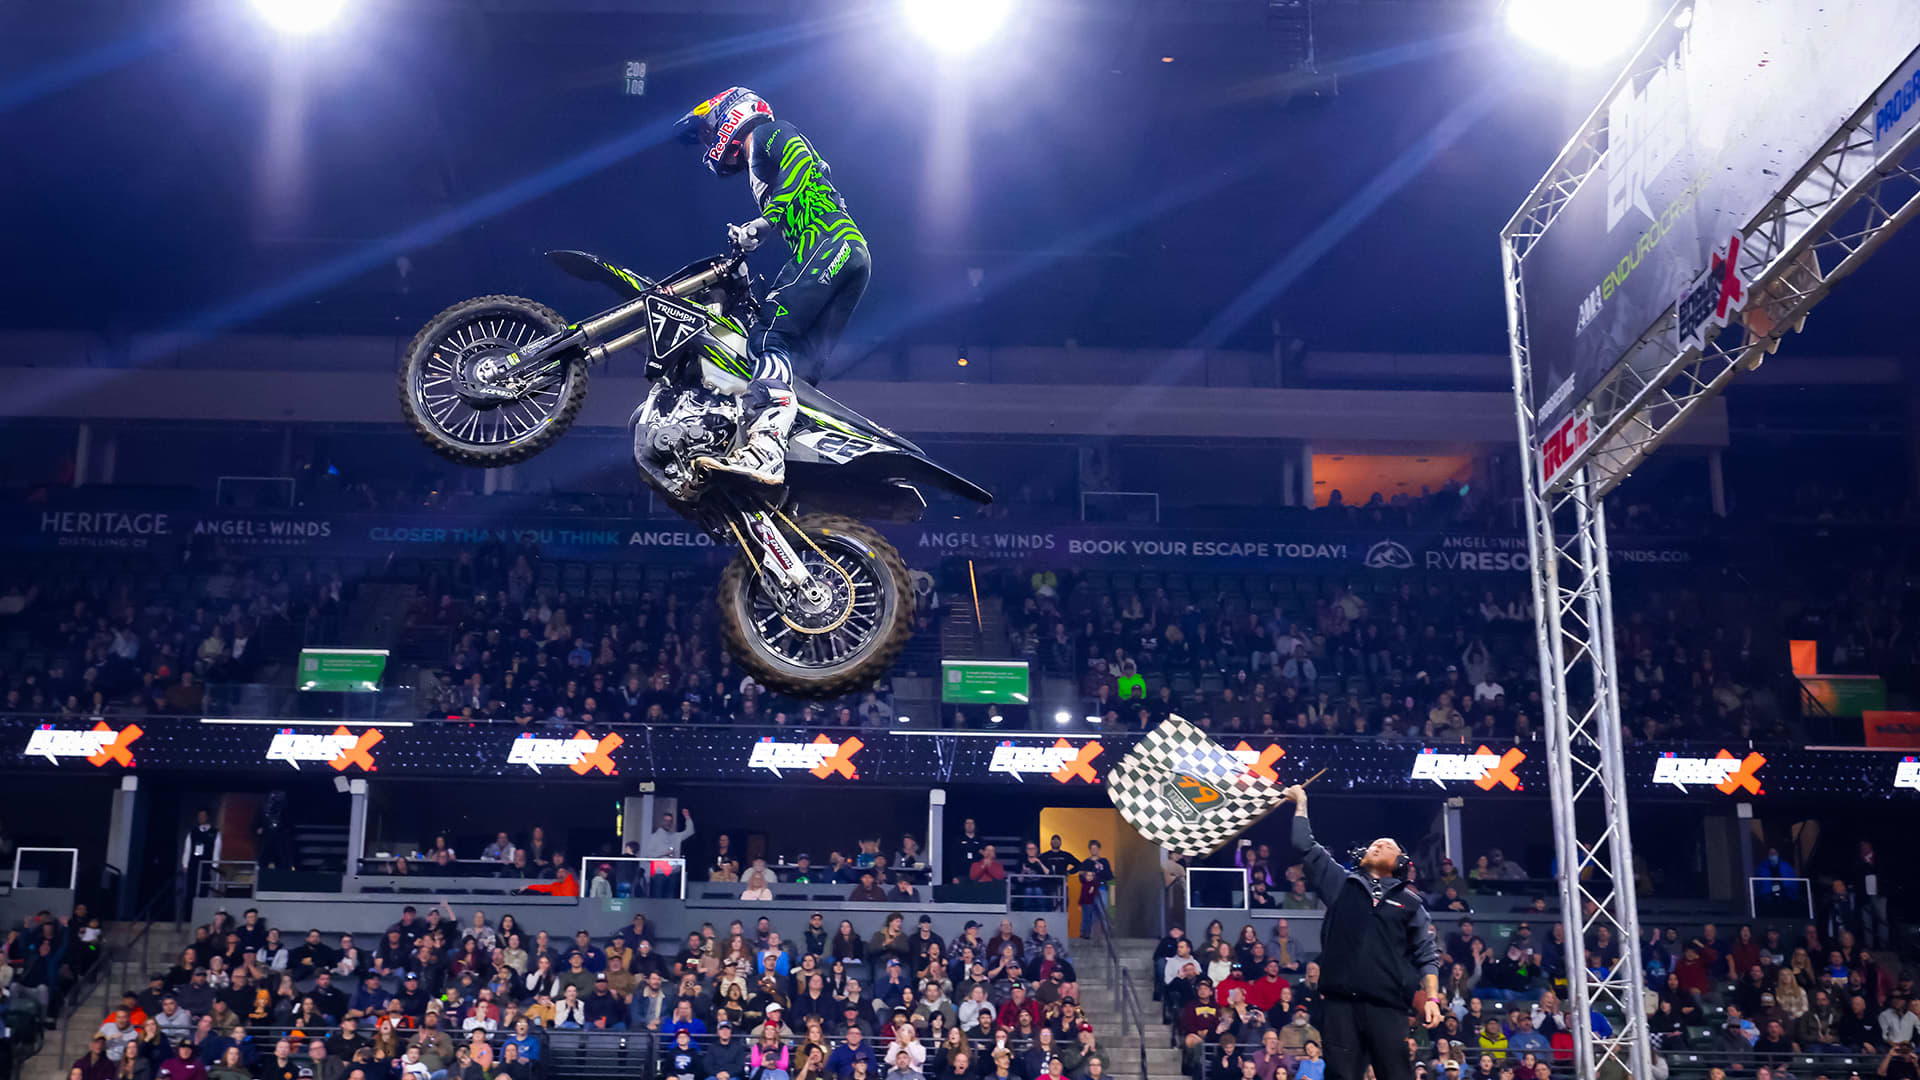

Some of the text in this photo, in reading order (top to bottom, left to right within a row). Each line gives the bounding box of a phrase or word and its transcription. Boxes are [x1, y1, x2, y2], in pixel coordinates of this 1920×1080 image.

[709, 132, 729, 161] Red
[721, 108, 745, 136] Bull
[656, 302, 697, 324] TRIUMPH
[816, 432, 874, 458] 22
[40, 511, 168, 534] HERITAGE
[194, 520, 254, 535] ANGEL
[269, 521, 331, 537] WINDS
[369, 528, 446, 543] CLOSER
[512, 530, 554, 545] YOU
[558, 530, 619, 546] THINK
[994, 533, 1056, 550] WINDS
[1443, 536, 1528, 549] ANGEL WIN
[1068, 539, 1347, 559] BOOK YOUR ESCAPE TODAY!
